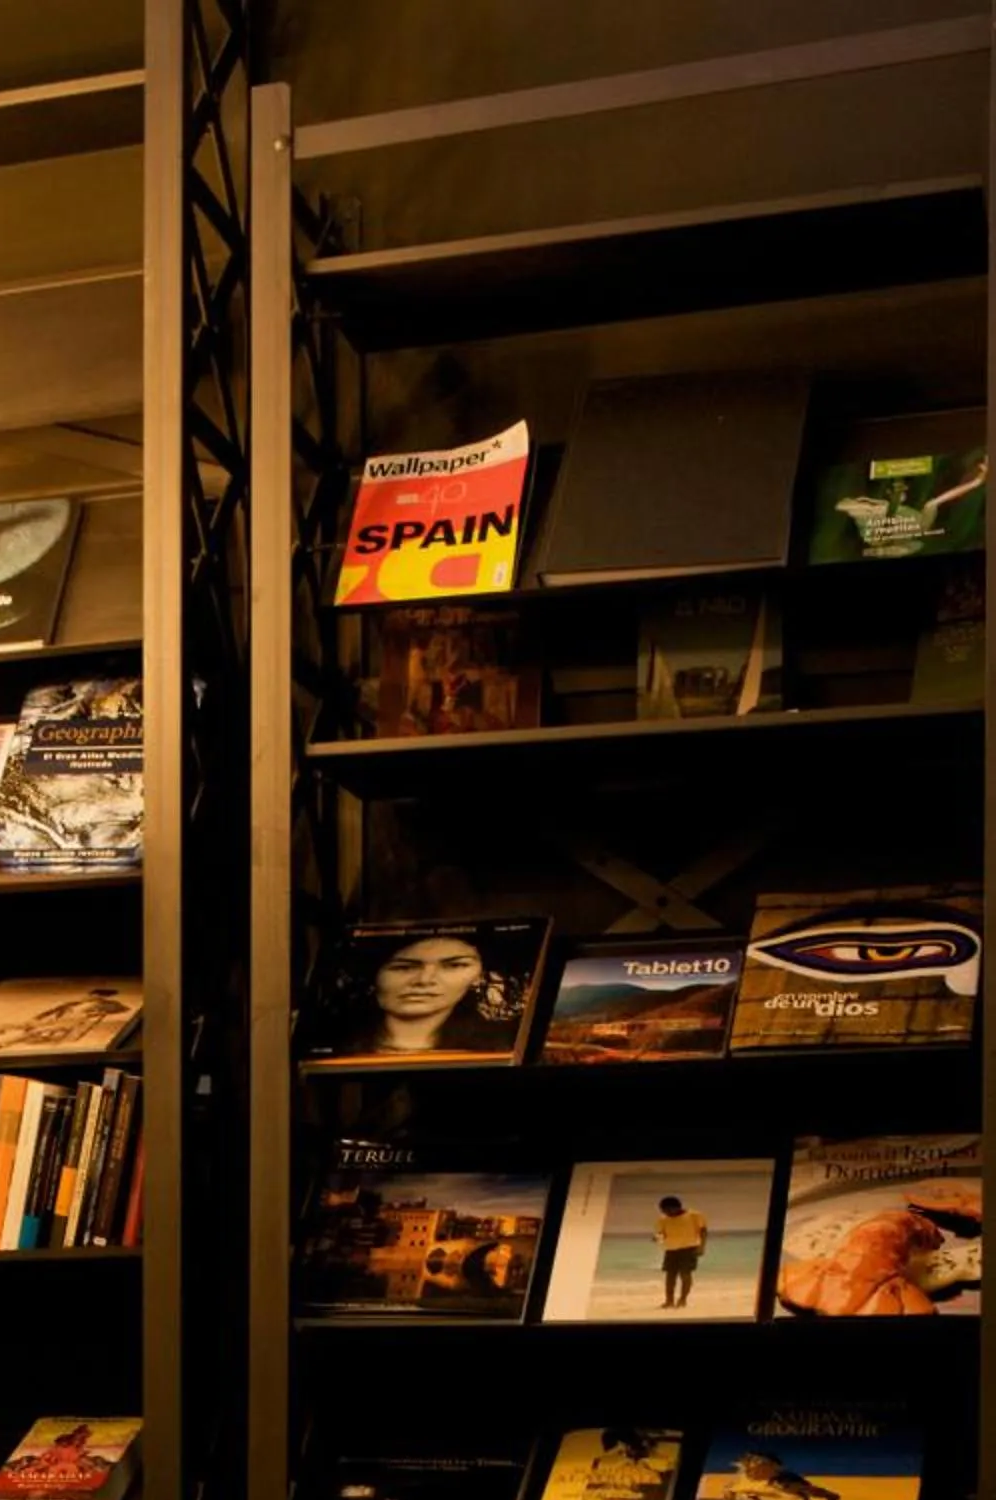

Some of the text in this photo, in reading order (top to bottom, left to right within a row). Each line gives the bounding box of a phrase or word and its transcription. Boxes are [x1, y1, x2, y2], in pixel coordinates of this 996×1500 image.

[368, 450, 491, 479] Wallpaper
[355, 503, 515, 554] SPAIN
[38, 723, 143, 745] Geographi
[764, 996, 788, 1009] de
[815, 1000, 880, 1017] dios
[340, 1148, 417, 1164] TERUEL
